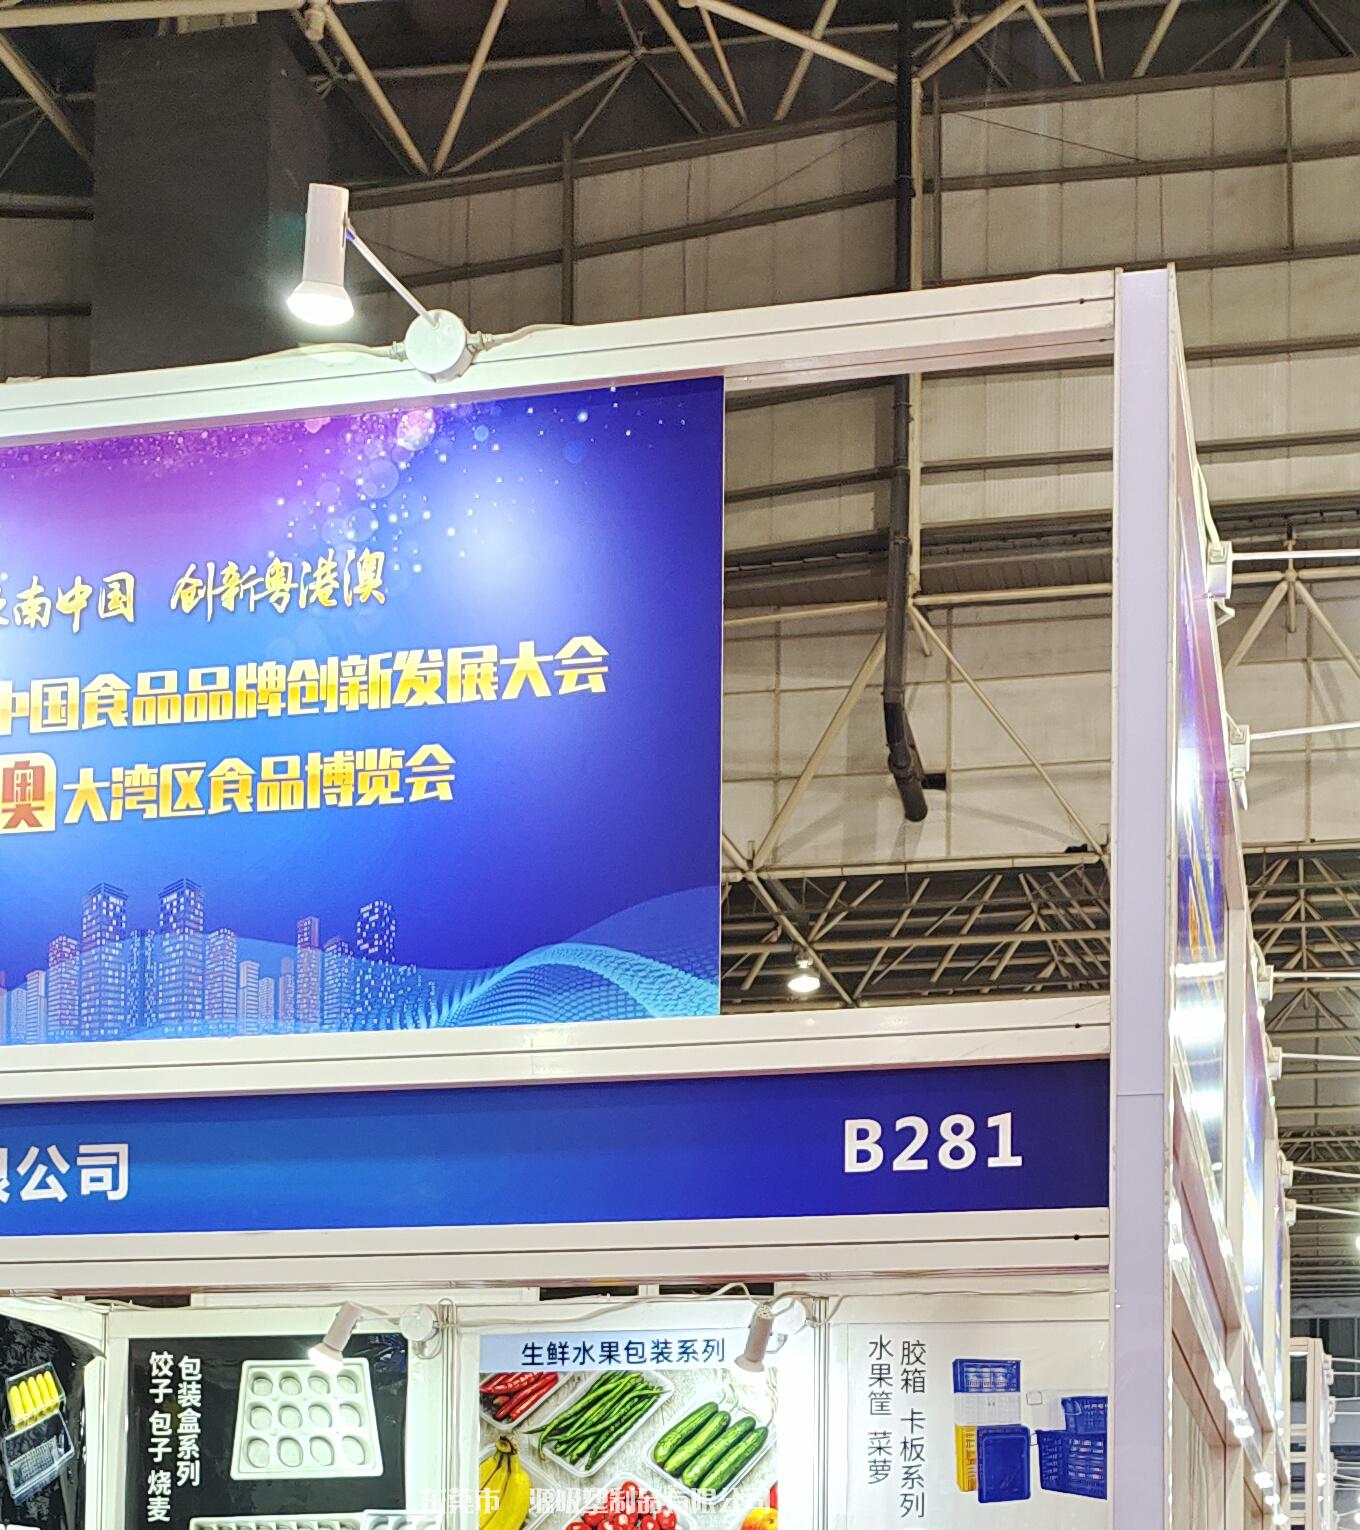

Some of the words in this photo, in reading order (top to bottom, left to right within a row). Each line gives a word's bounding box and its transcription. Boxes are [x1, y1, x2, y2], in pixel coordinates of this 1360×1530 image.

[169, 548, 387, 625] 创新粤港澳
[63, 743, 457, 827] 大湾区食品博览会
[844, 1111, 1023, 1173] B281
[149, 1351, 174, 1404] 饺子
[521, 1337, 726, 1367] 生鲜水果包装系列
[867, 1334, 893, 1416] 水果筐
[899, 1340, 927, 1394] 胶箱
[148, 1410, 173, 1463] 包子
[177, 1355, 202, 1487] 包装盒系列
[899, 1408, 926, 1519] 卡板系列
[147, 1470, 172, 1522] 烧麦
